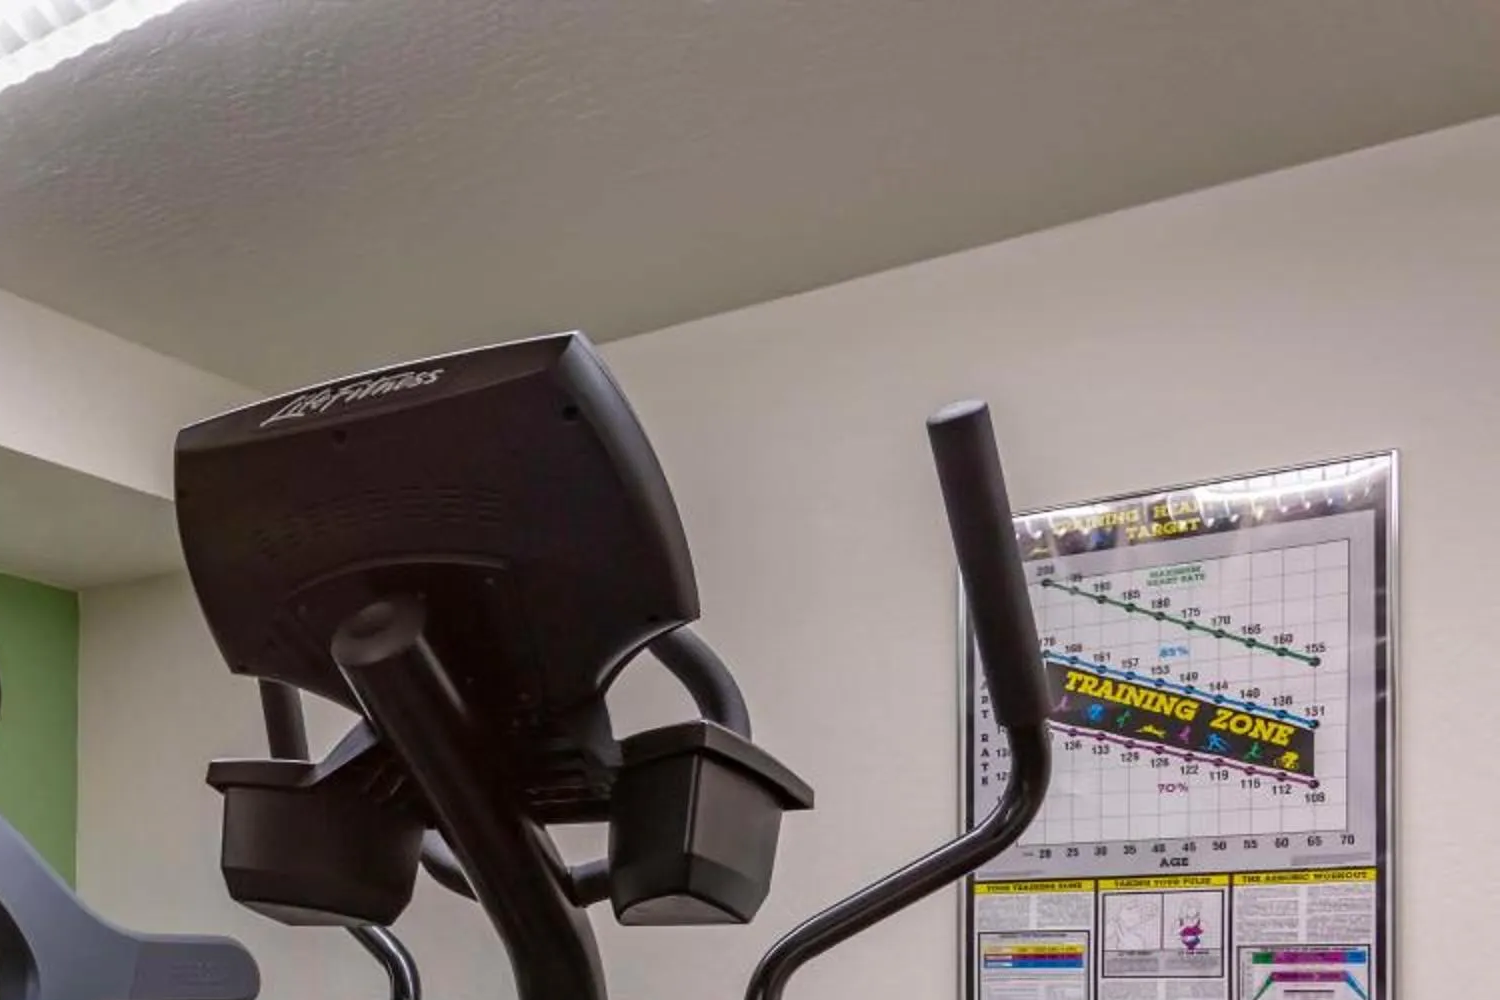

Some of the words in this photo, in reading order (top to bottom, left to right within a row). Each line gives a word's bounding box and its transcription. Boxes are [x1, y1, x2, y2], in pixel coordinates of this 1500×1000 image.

[1181, 608, 1201, 618] 175
[1305, 642, 1326, 653] 155
[1121, 658, 1140, 668] 157
[1064, 671, 1199, 721] TRAINING
[1209, 707, 1295, 747] ZONE
[1180, 765, 1199, 775] 122
[1210, 770, 1228, 780] 119
[1272, 785, 1292, 795] 112
[1066, 847, 1079, 857] 25
[1123, 845, 1136, 855] 35
[1212, 840, 1227, 850] 50
[1243, 839, 1258, 849] 55
[1275, 837, 1289, 848] 60
[1307, 836, 1323, 846] 65
[1341, 834, 1355, 845] 70
[1159, 857, 1189, 868] AGE
